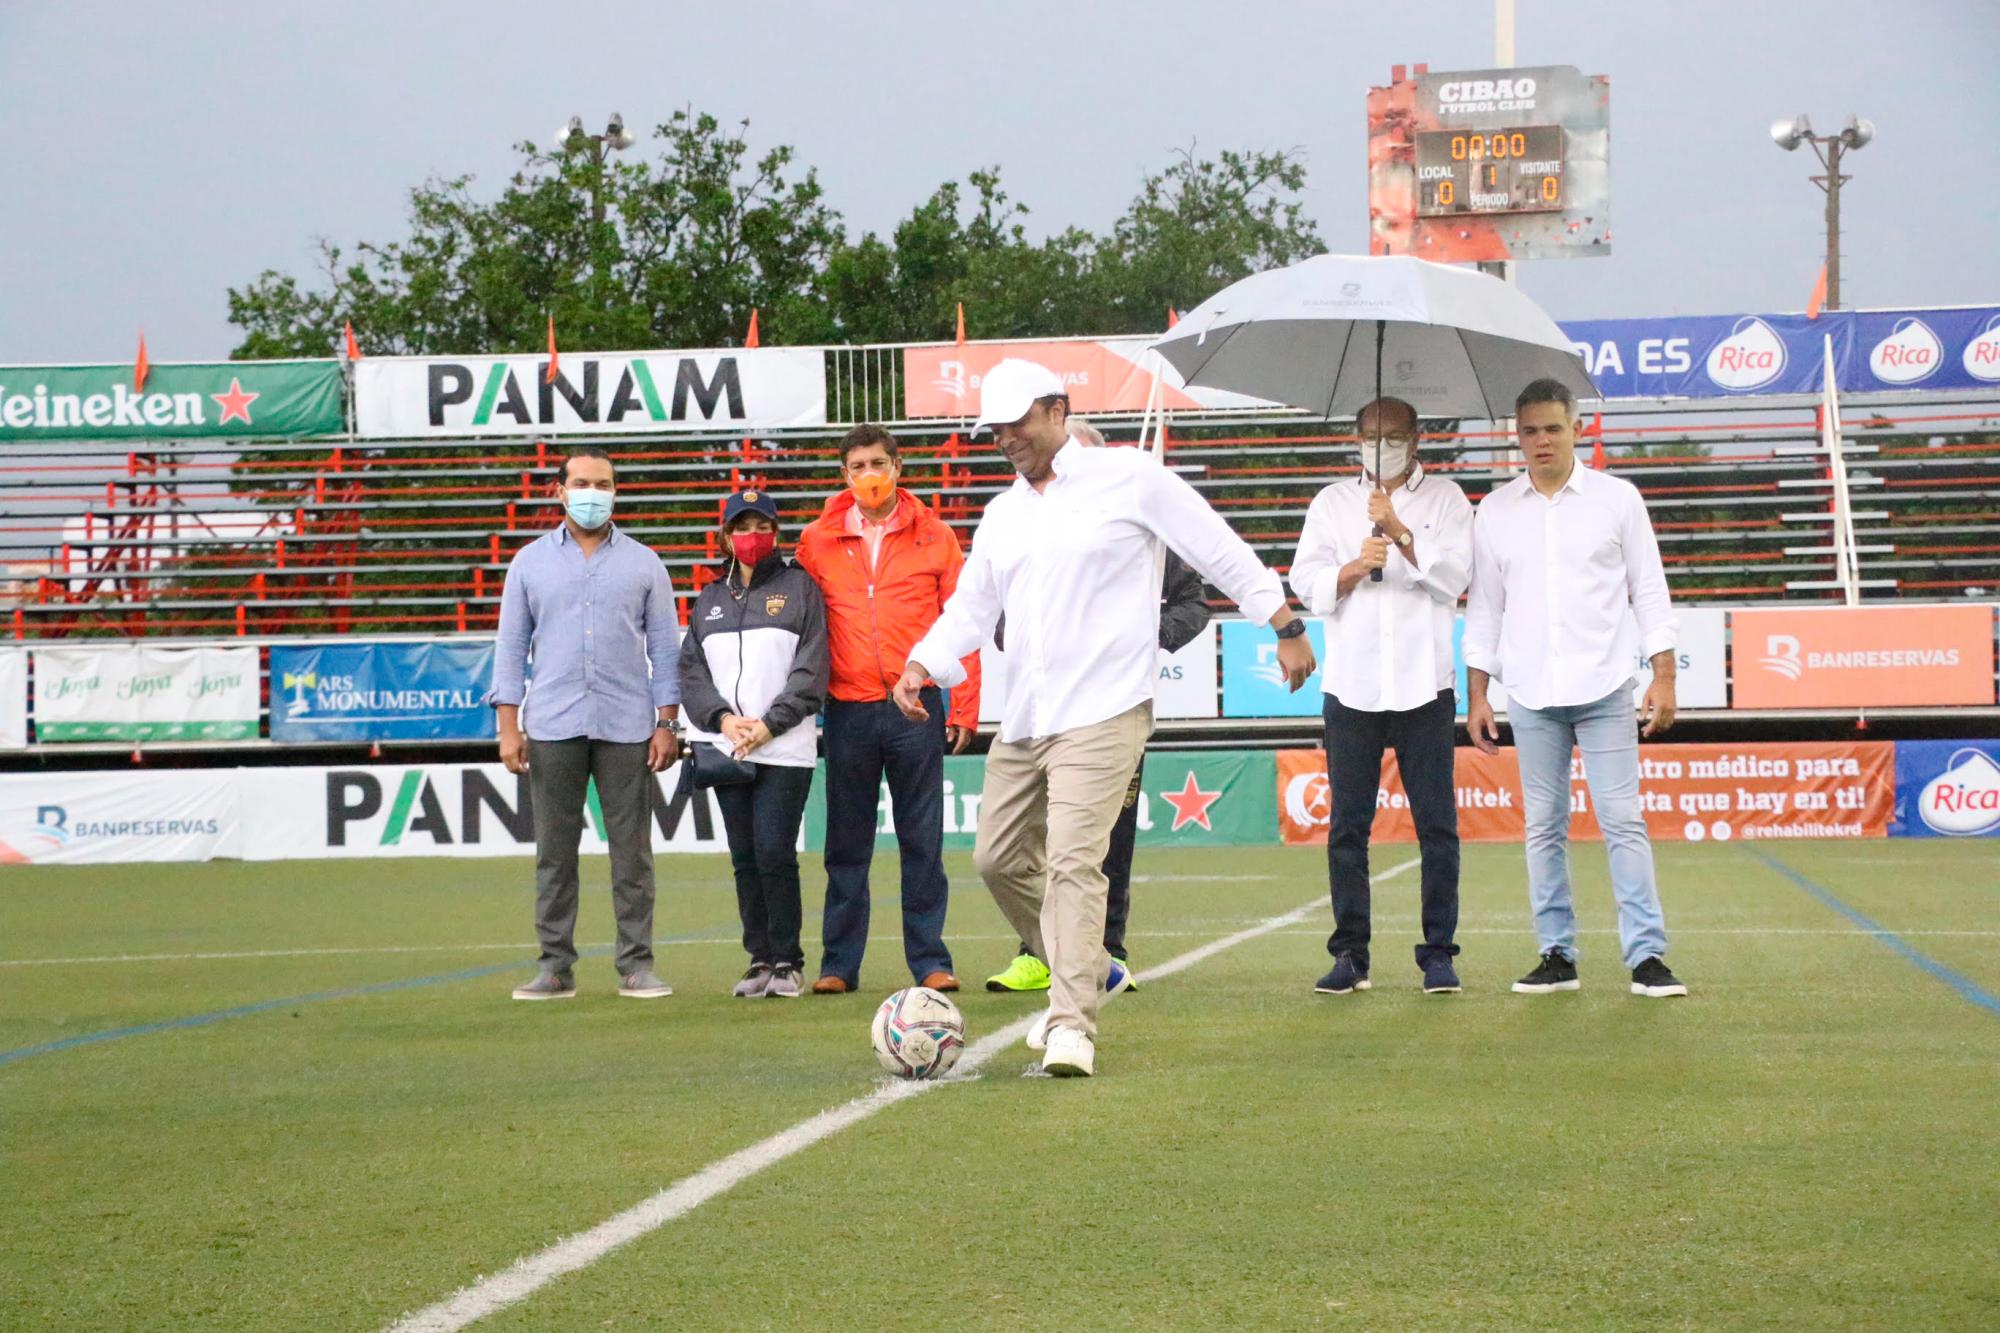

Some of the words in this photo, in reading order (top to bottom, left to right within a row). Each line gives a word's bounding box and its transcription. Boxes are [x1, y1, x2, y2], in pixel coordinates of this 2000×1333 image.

[1439, 78, 1536, 103] CIBAO
[1498, 99, 1536, 111] CLUB
[1451, 133, 1526, 160] 00:00
[1419, 166, 1454, 179] LOCAL
[1520, 161, 1560, 174] VISITANTE
[1439, 181, 1454, 205] 0
[1470, 193, 1508, 206] PERIODO
[1542, 176, 1558, 200] 0
[1638, 338, 1691, 374] ES
[1719, 345, 1774, 372] Rica
[1881, 344, 1931, 367] Rica
[428, 357, 747, 427] PANAM
[0, 384, 206, 428] eineken
[1807, 649, 1960, 669] BANRESERVAS
[317, 675, 353, 692] ARS
[317, 690, 480, 711] MONUMENTAL
[1688, 755, 1789, 779] médico
[1796, 758, 1859, 781] para
[1680, 793, 1730, 816] que
[1736, 788, 1788, 815] hay
[1794, 792, 1828, 810] en
[1835, 787, 1866, 810] ti!
[1933, 783, 2000, 814] Rica
[75, 819, 218, 837] BANRESERVAS
[1742, 822, 1863, 837] @rehabilitekrd
